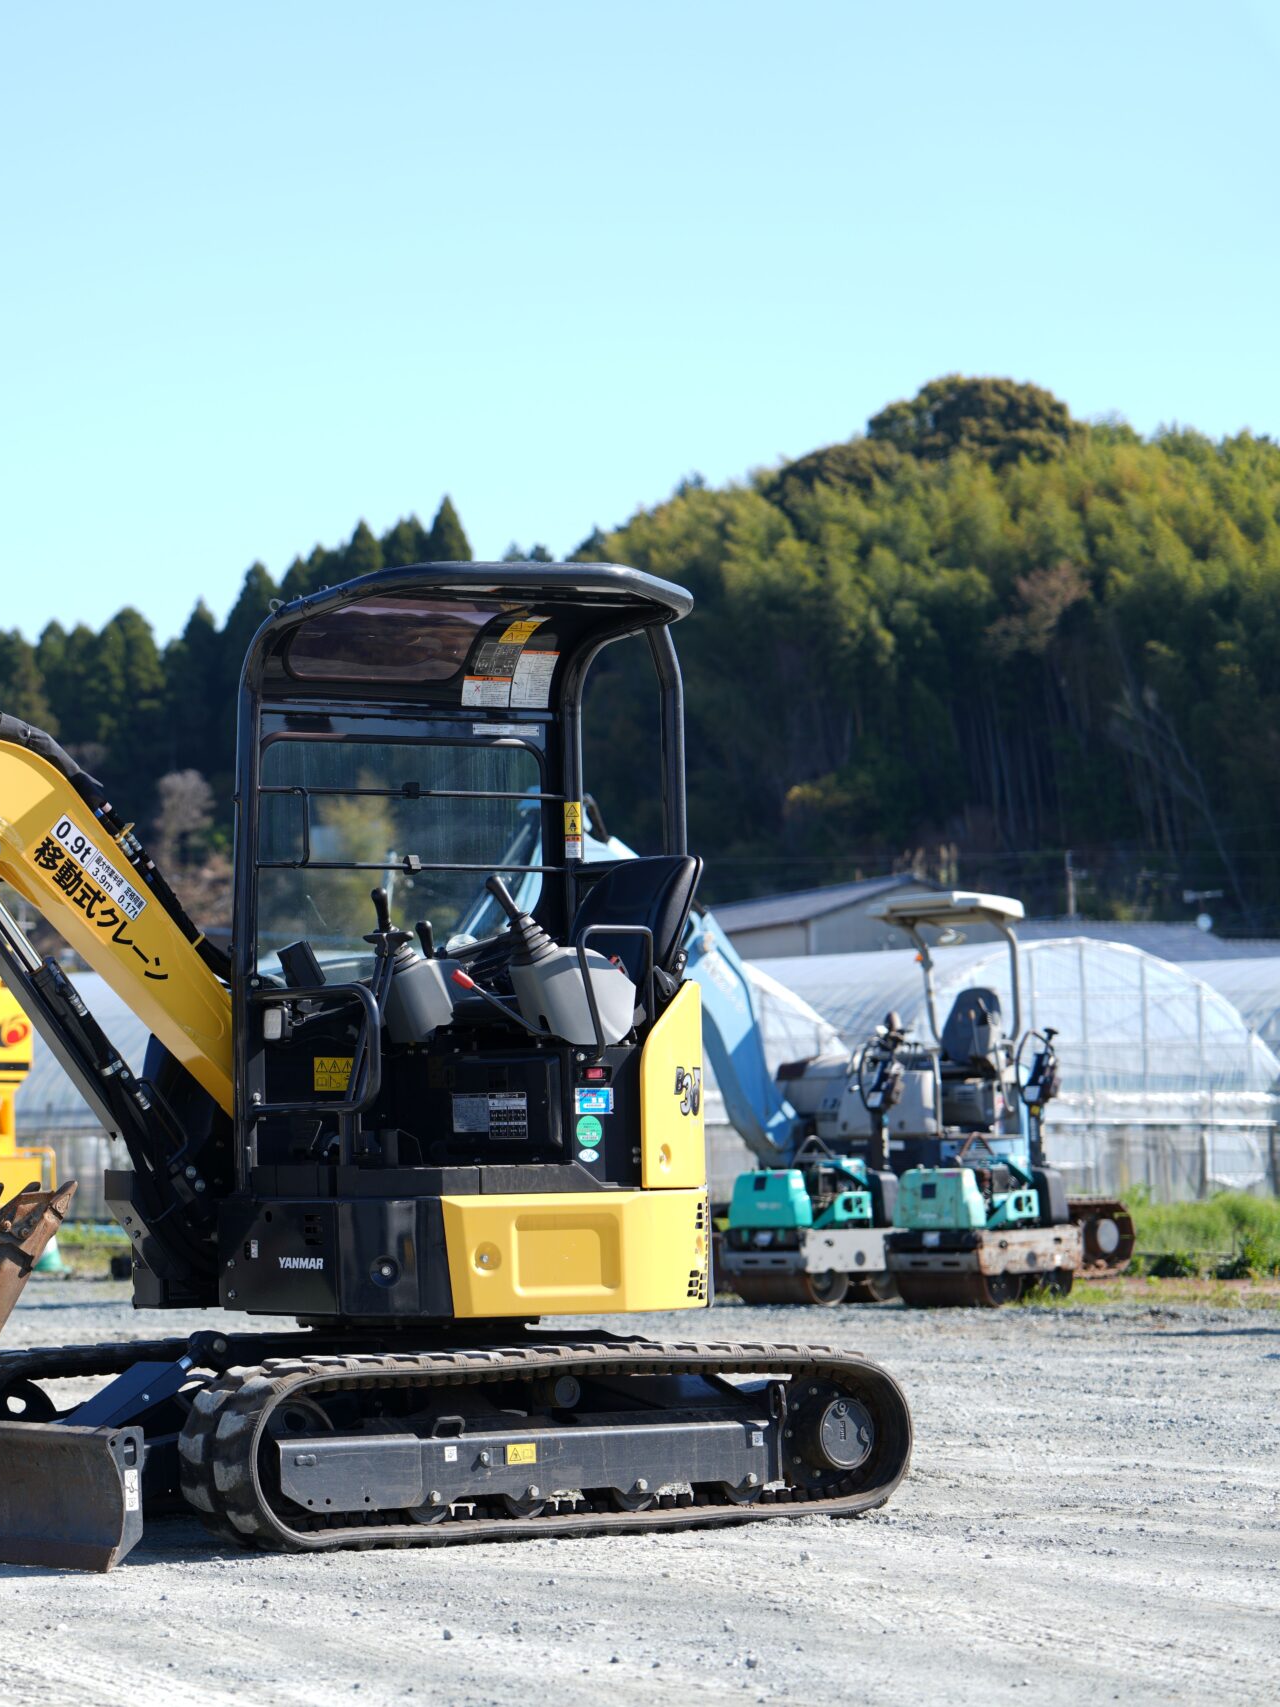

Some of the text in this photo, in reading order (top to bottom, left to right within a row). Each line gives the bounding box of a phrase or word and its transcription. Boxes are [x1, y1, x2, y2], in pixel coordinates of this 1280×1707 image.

[56, 820, 92, 864] 0.9t
[91, 867, 139, 919] 3.9m 0.17t
[94, 855, 124, 888] 最大作業半径
[33, 836, 169, 980] 移動式クレーン
[278, 1256, 324, 1270] YANMAR
